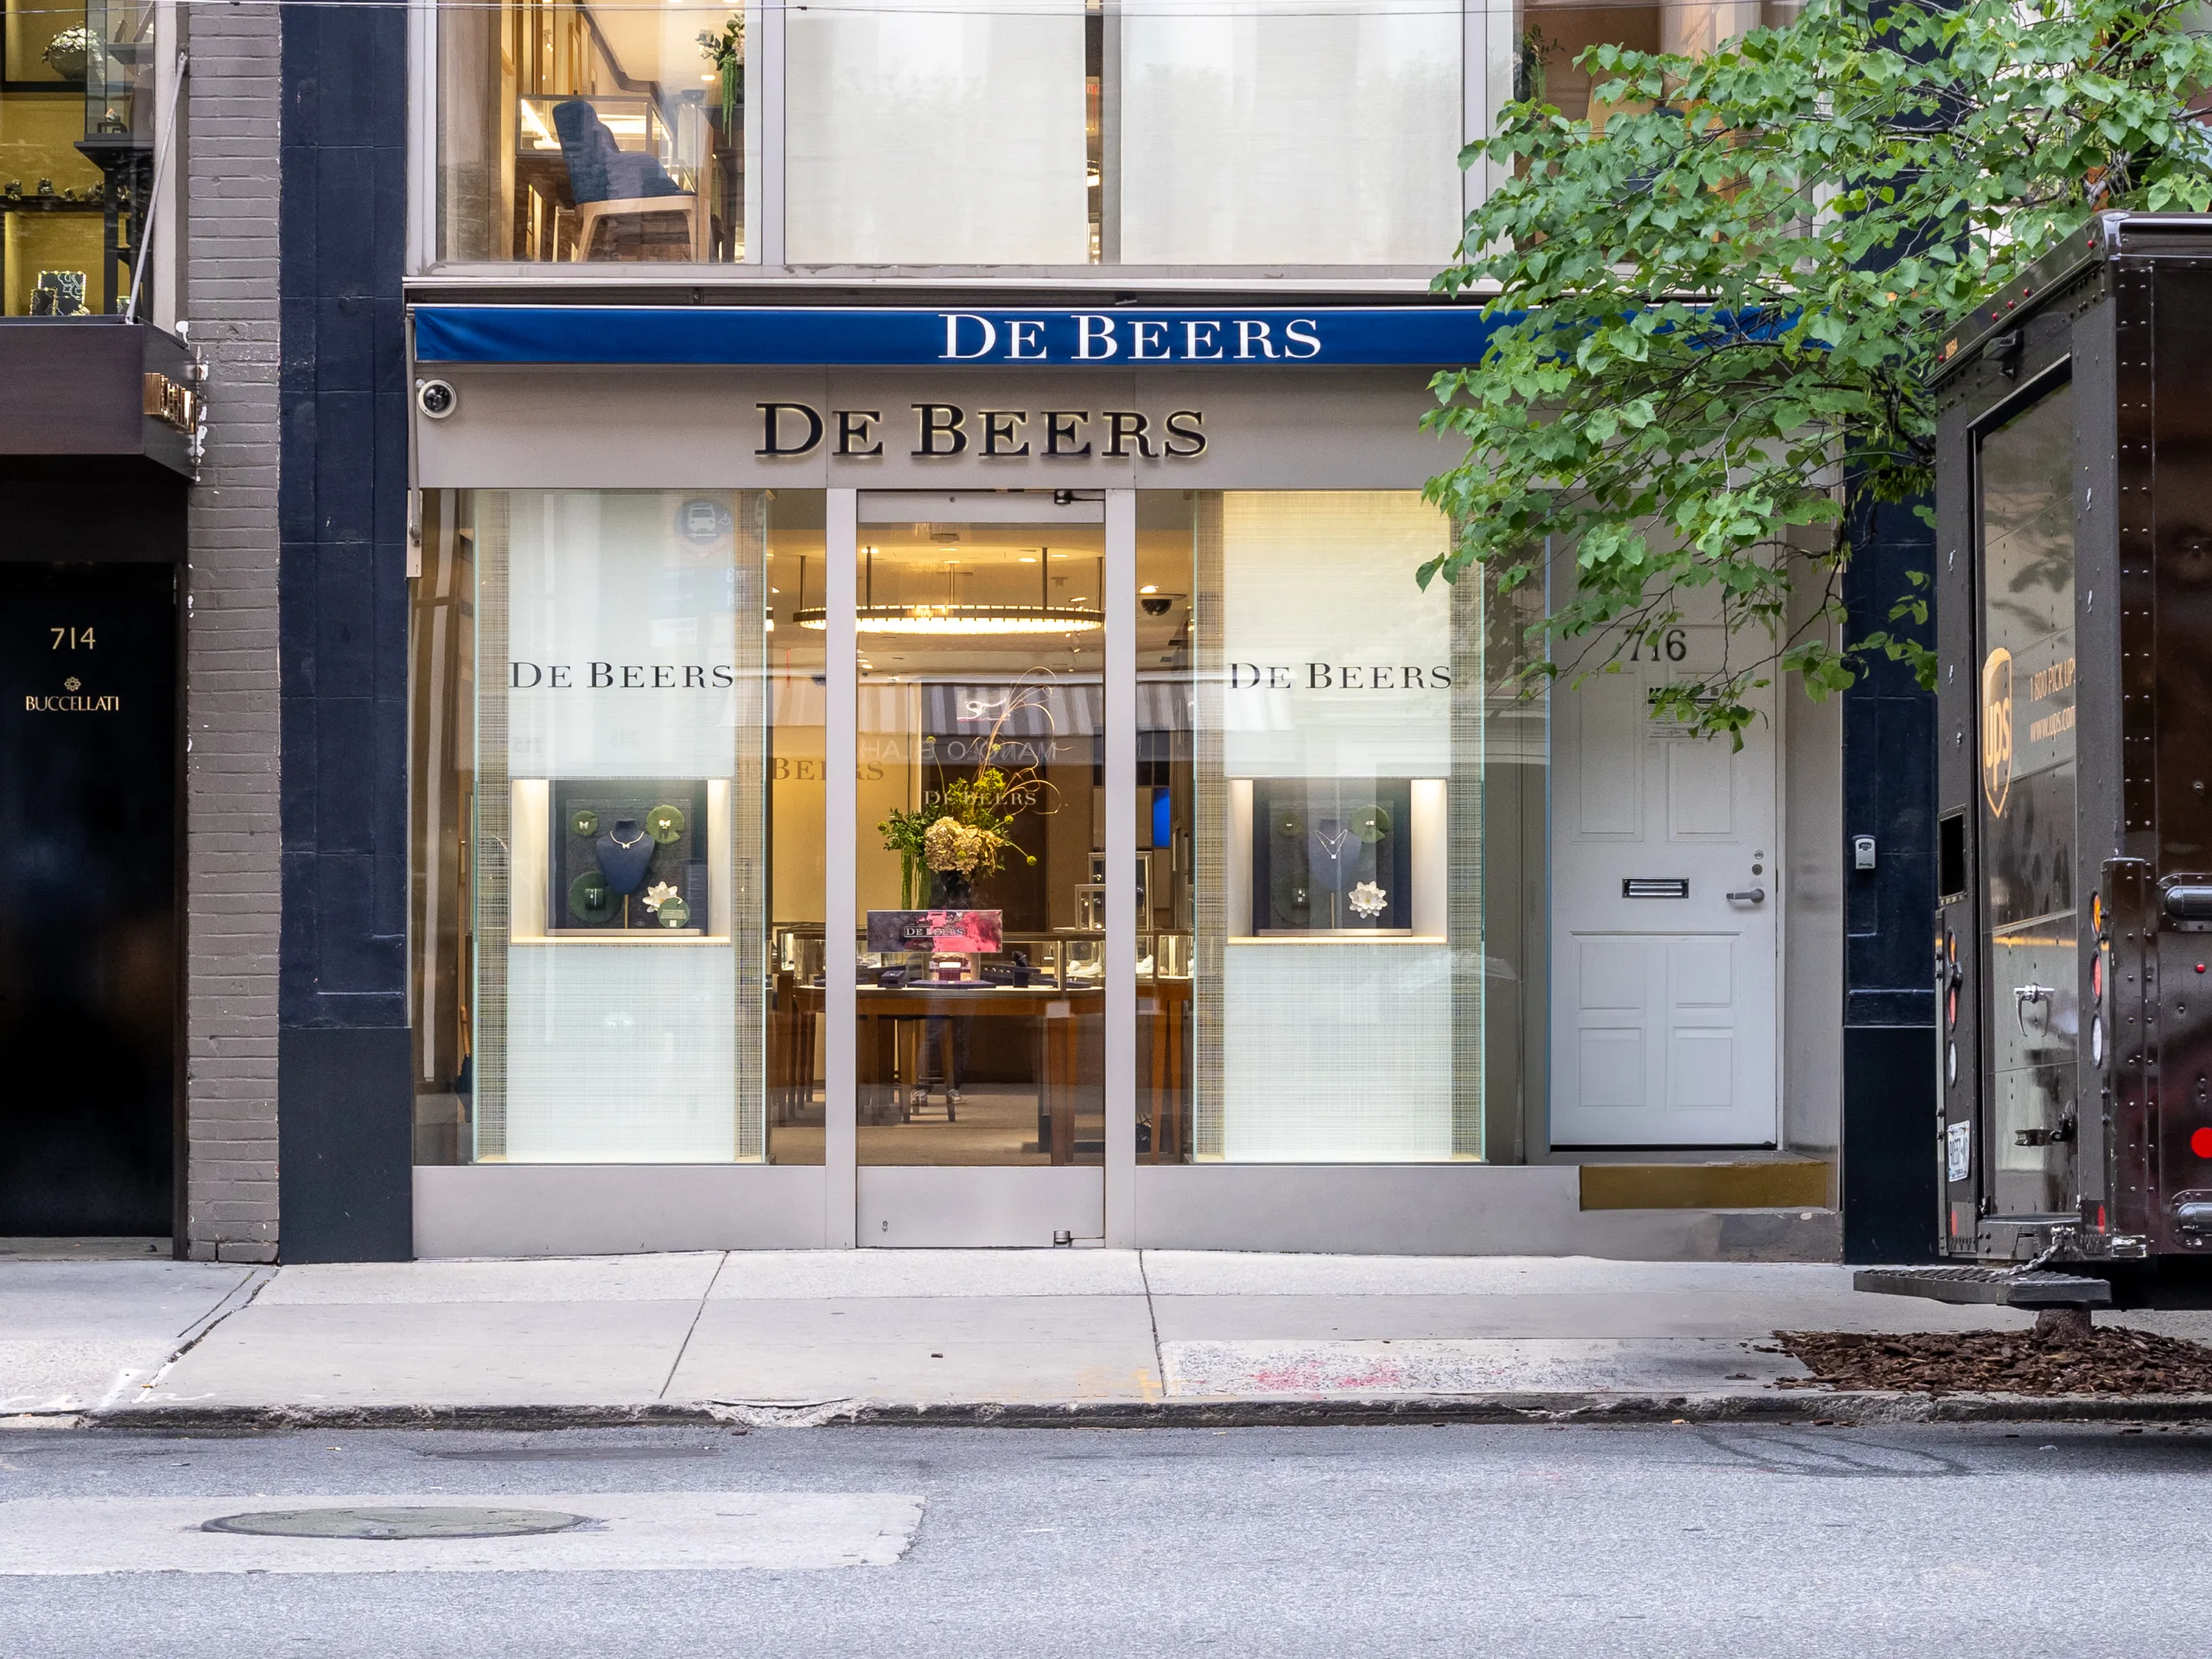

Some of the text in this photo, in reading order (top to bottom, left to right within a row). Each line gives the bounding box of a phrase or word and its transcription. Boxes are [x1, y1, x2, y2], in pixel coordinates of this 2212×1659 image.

[938, 315, 1322, 359] DE BEERS
[754, 404, 1207, 458] DE BEERS
[50, 627, 96, 650] 714
[509, 662, 734, 689] DE BEERS
[1228, 663, 1452, 690] DE BEERS
[2049, 663, 2063, 695] PICK
[26, 696, 119, 711] BUCCELLATI
[1985, 697, 2009, 791] ups
[772, 758, 884, 781] BES
